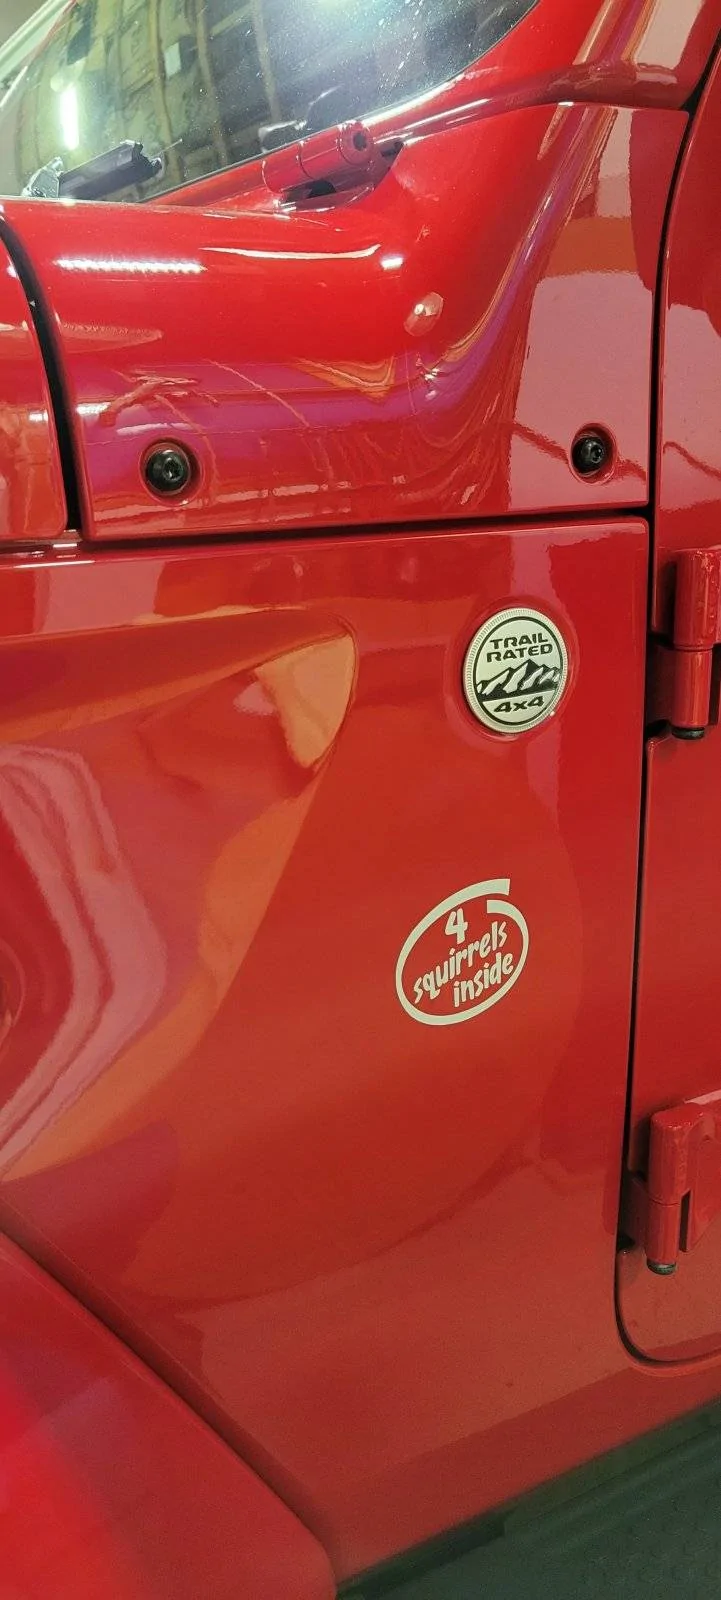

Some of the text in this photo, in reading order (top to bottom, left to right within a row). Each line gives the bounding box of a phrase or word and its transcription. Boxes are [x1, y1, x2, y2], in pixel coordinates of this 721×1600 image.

[486, 643, 553, 662] RATED
[490, 633, 548, 649] TRAIL
[494, 696, 544, 712] 4x4
[445, 908, 468, 944] 4
[413, 921, 507, 1004] squirrels
[454, 952, 514, 1008] inside
